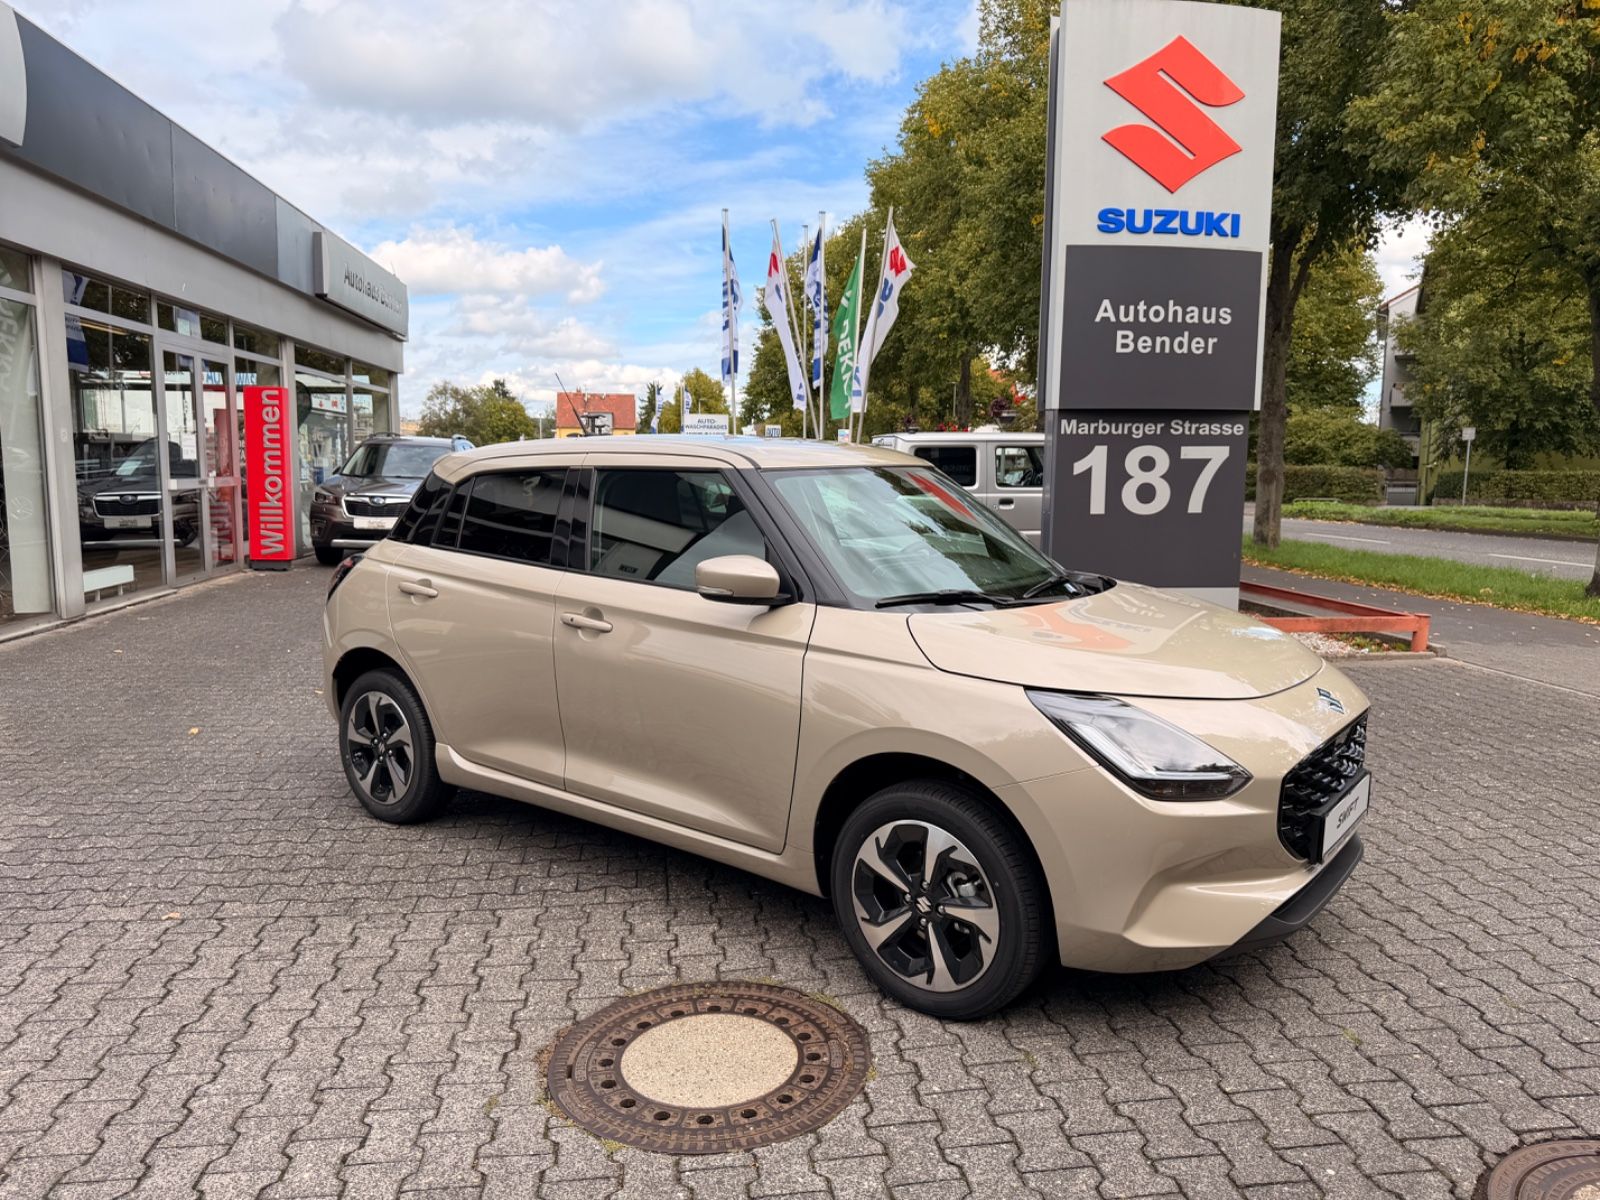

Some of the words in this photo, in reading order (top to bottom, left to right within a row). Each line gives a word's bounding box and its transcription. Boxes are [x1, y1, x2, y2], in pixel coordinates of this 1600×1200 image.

[1097, 207, 1242, 237] SUZUKI
[1094, 298, 1232, 325] Autohaus
[1115, 330, 1218, 355] Bender
[1060, 419, 1164, 440] Marburger
[1170, 419, 1244, 436] Strasse
[259, 389, 285, 555] Willkommen
[1072, 445, 1230, 515] 187
